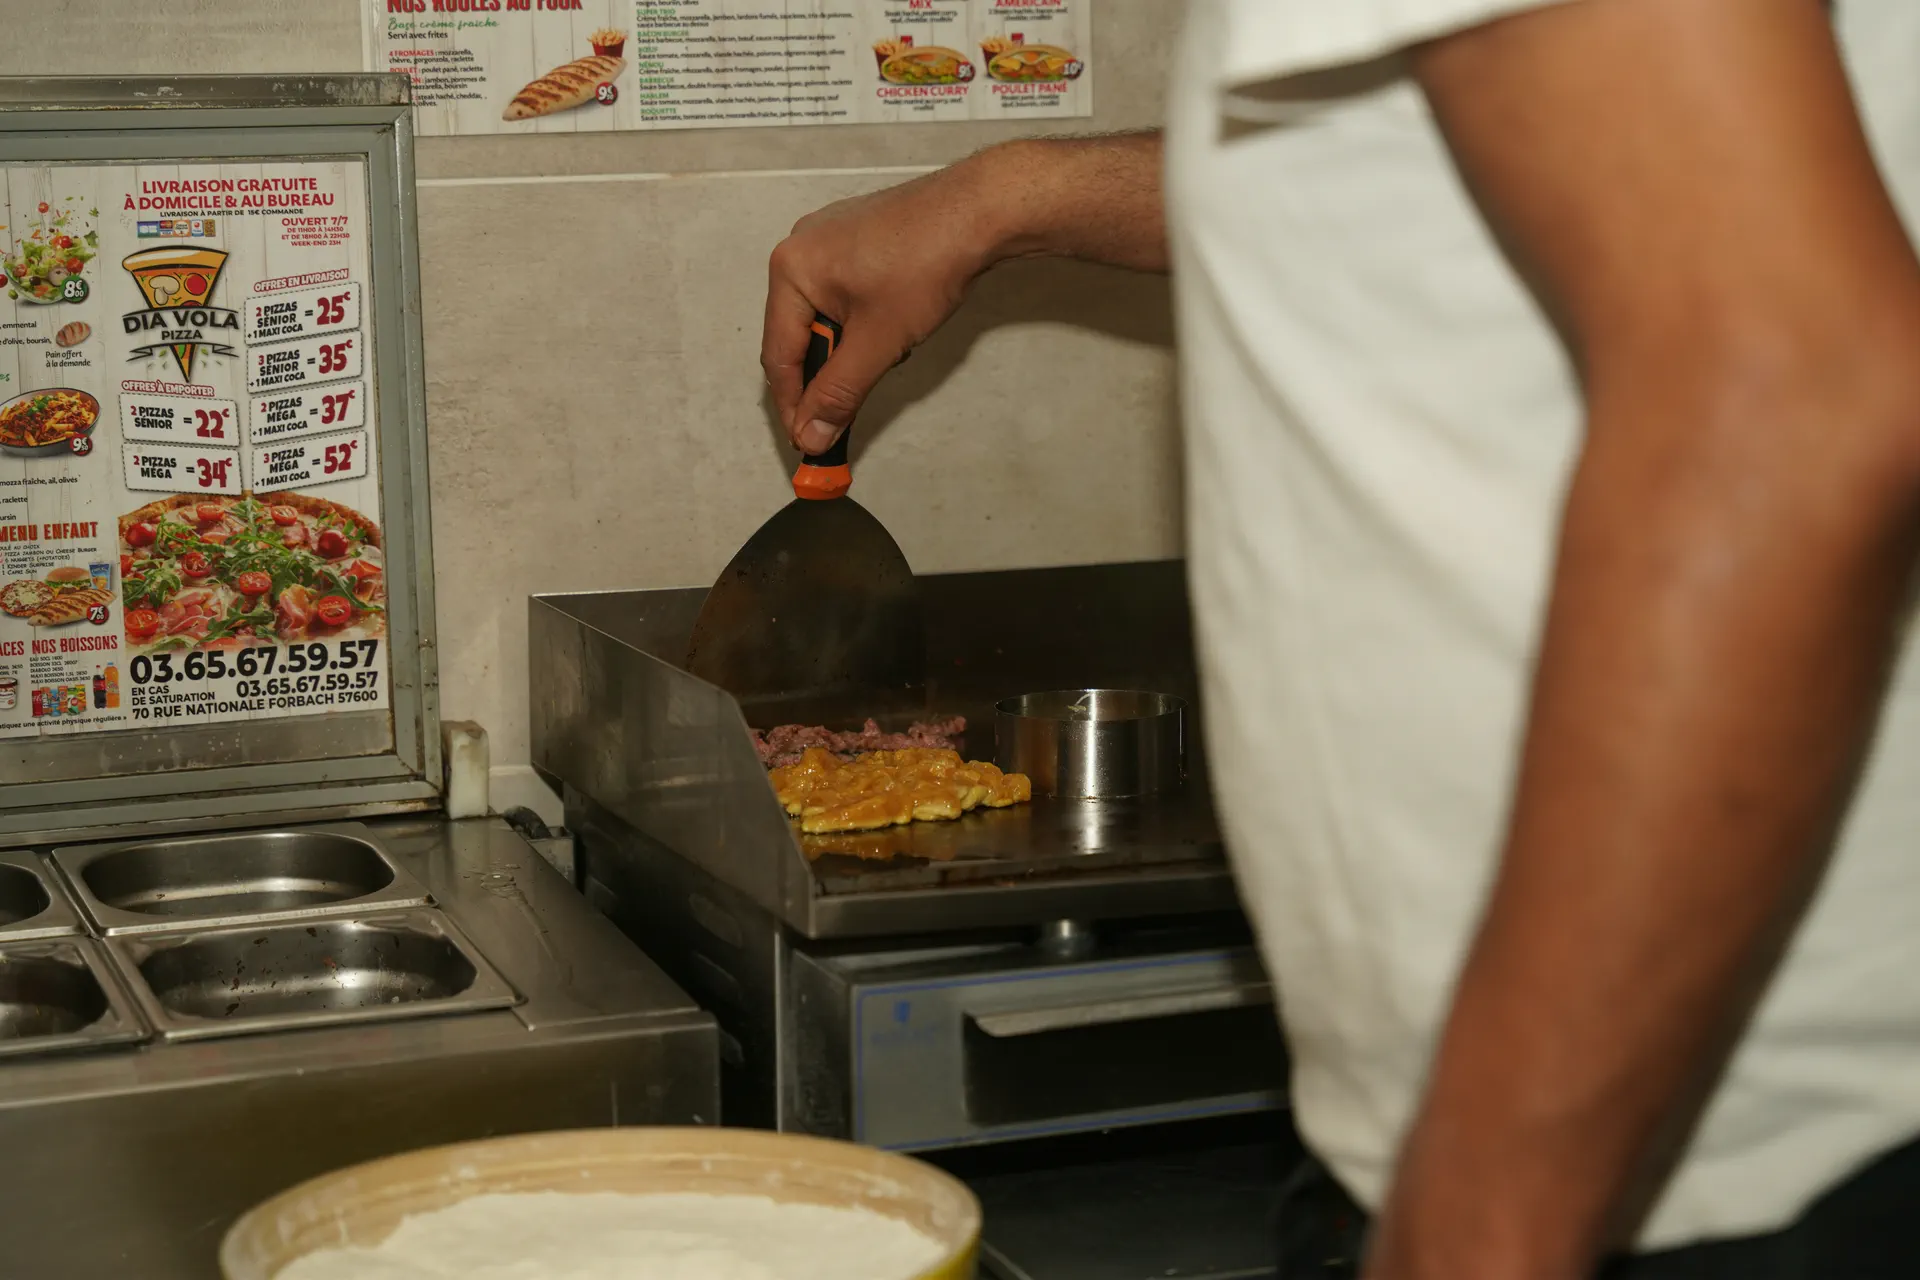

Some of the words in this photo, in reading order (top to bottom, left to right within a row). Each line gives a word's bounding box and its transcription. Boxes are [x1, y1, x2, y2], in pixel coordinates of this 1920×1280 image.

[142, 179, 234, 194] LIVRAISON
[237, 178, 318, 192] GRATUITE
[124, 194, 136, 210] À
[139, 195, 221, 210] DOMICILE
[225, 195, 237, 209] &
[241, 195, 265, 208] AU
[268, 193, 334, 207] BUREAU
[282, 218, 329, 226] OUVERT
[331, 216, 348, 226] 7/7
[254, 279, 287, 292] OFFRES
[288, 277, 300, 288] EN
[301, 269, 349, 285] LIVRAISON
[256, 307, 262, 317] 2
[264, 301, 298, 316] PIZZAS
[123, 312, 167, 334] DIA
[172, 310, 240, 330] VOLA
[257, 313, 296, 328] SÉNIOR
[161, 330, 203, 340] PIZZA
[253, 330, 257, 338] 1
[259, 327, 280, 338] MAXI
[282, 324, 303, 334] COCA
[62, 350, 82, 360] offert
[258, 355, 264, 366] 3
[266, 350, 300, 364] PIZZAS
[59, 359, 91, 367] demande
[260, 361, 299, 376] SÉNIOR
[256, 379, 260, 387] 1
[261, 376, 282, 386] MAXI
[284, 372, 305, 382] COCA
[122, 380, 156, 392] OFFRES
[157, 380, 164, 393] À
[166, 384, 214, 397] EMPORTER
[130, 406, 137, 416] 2
[139, 406, 174, 418] PIZZAS
[260, 402, 267, 412] 2
[268, 397, 302, 412] PIZZAS
[134, 415, 173, 430] SÉNIOR
[258, 428, 262, 436] 1
[264, 424, 285, 435] MAXI
[287, 420, 308, 431] COCA
[133, 455, 140, 466] 2
[142, 456, 177, 468] PIZZAS
[264, 453, 270, 464] 3
[271, 447, 305, 462] PIZZAS
[266, 475, 287, 485] MAXI
[289, 471, 310, 481] COCA
[0, 525, 37, 542] MENU
[44, 522, 98, 540] ENFANT
[32, 639, 56, 654] NOS
[60, 635, 118, 653] BOISSONS
[130, 639, 378, 684] 03.65.67.59.57
[132, 687, 146, 696] EN
[148, 685, 169, 695] CAS
[236, 671, 378, 698] 03.65.67.59.57
[132, 696, 146, 706] DE
[148, 692, 215, 705] SATURATION
[132, 708, 149, 720] 70
[154, 705, 182, 718] RUE
[186, 699, 265, 716] NATIONALE
[269, 693, 334, 709] FORBACH
[338, 690, 378, 703] 57600
[62, 717, 91, 726] physique
